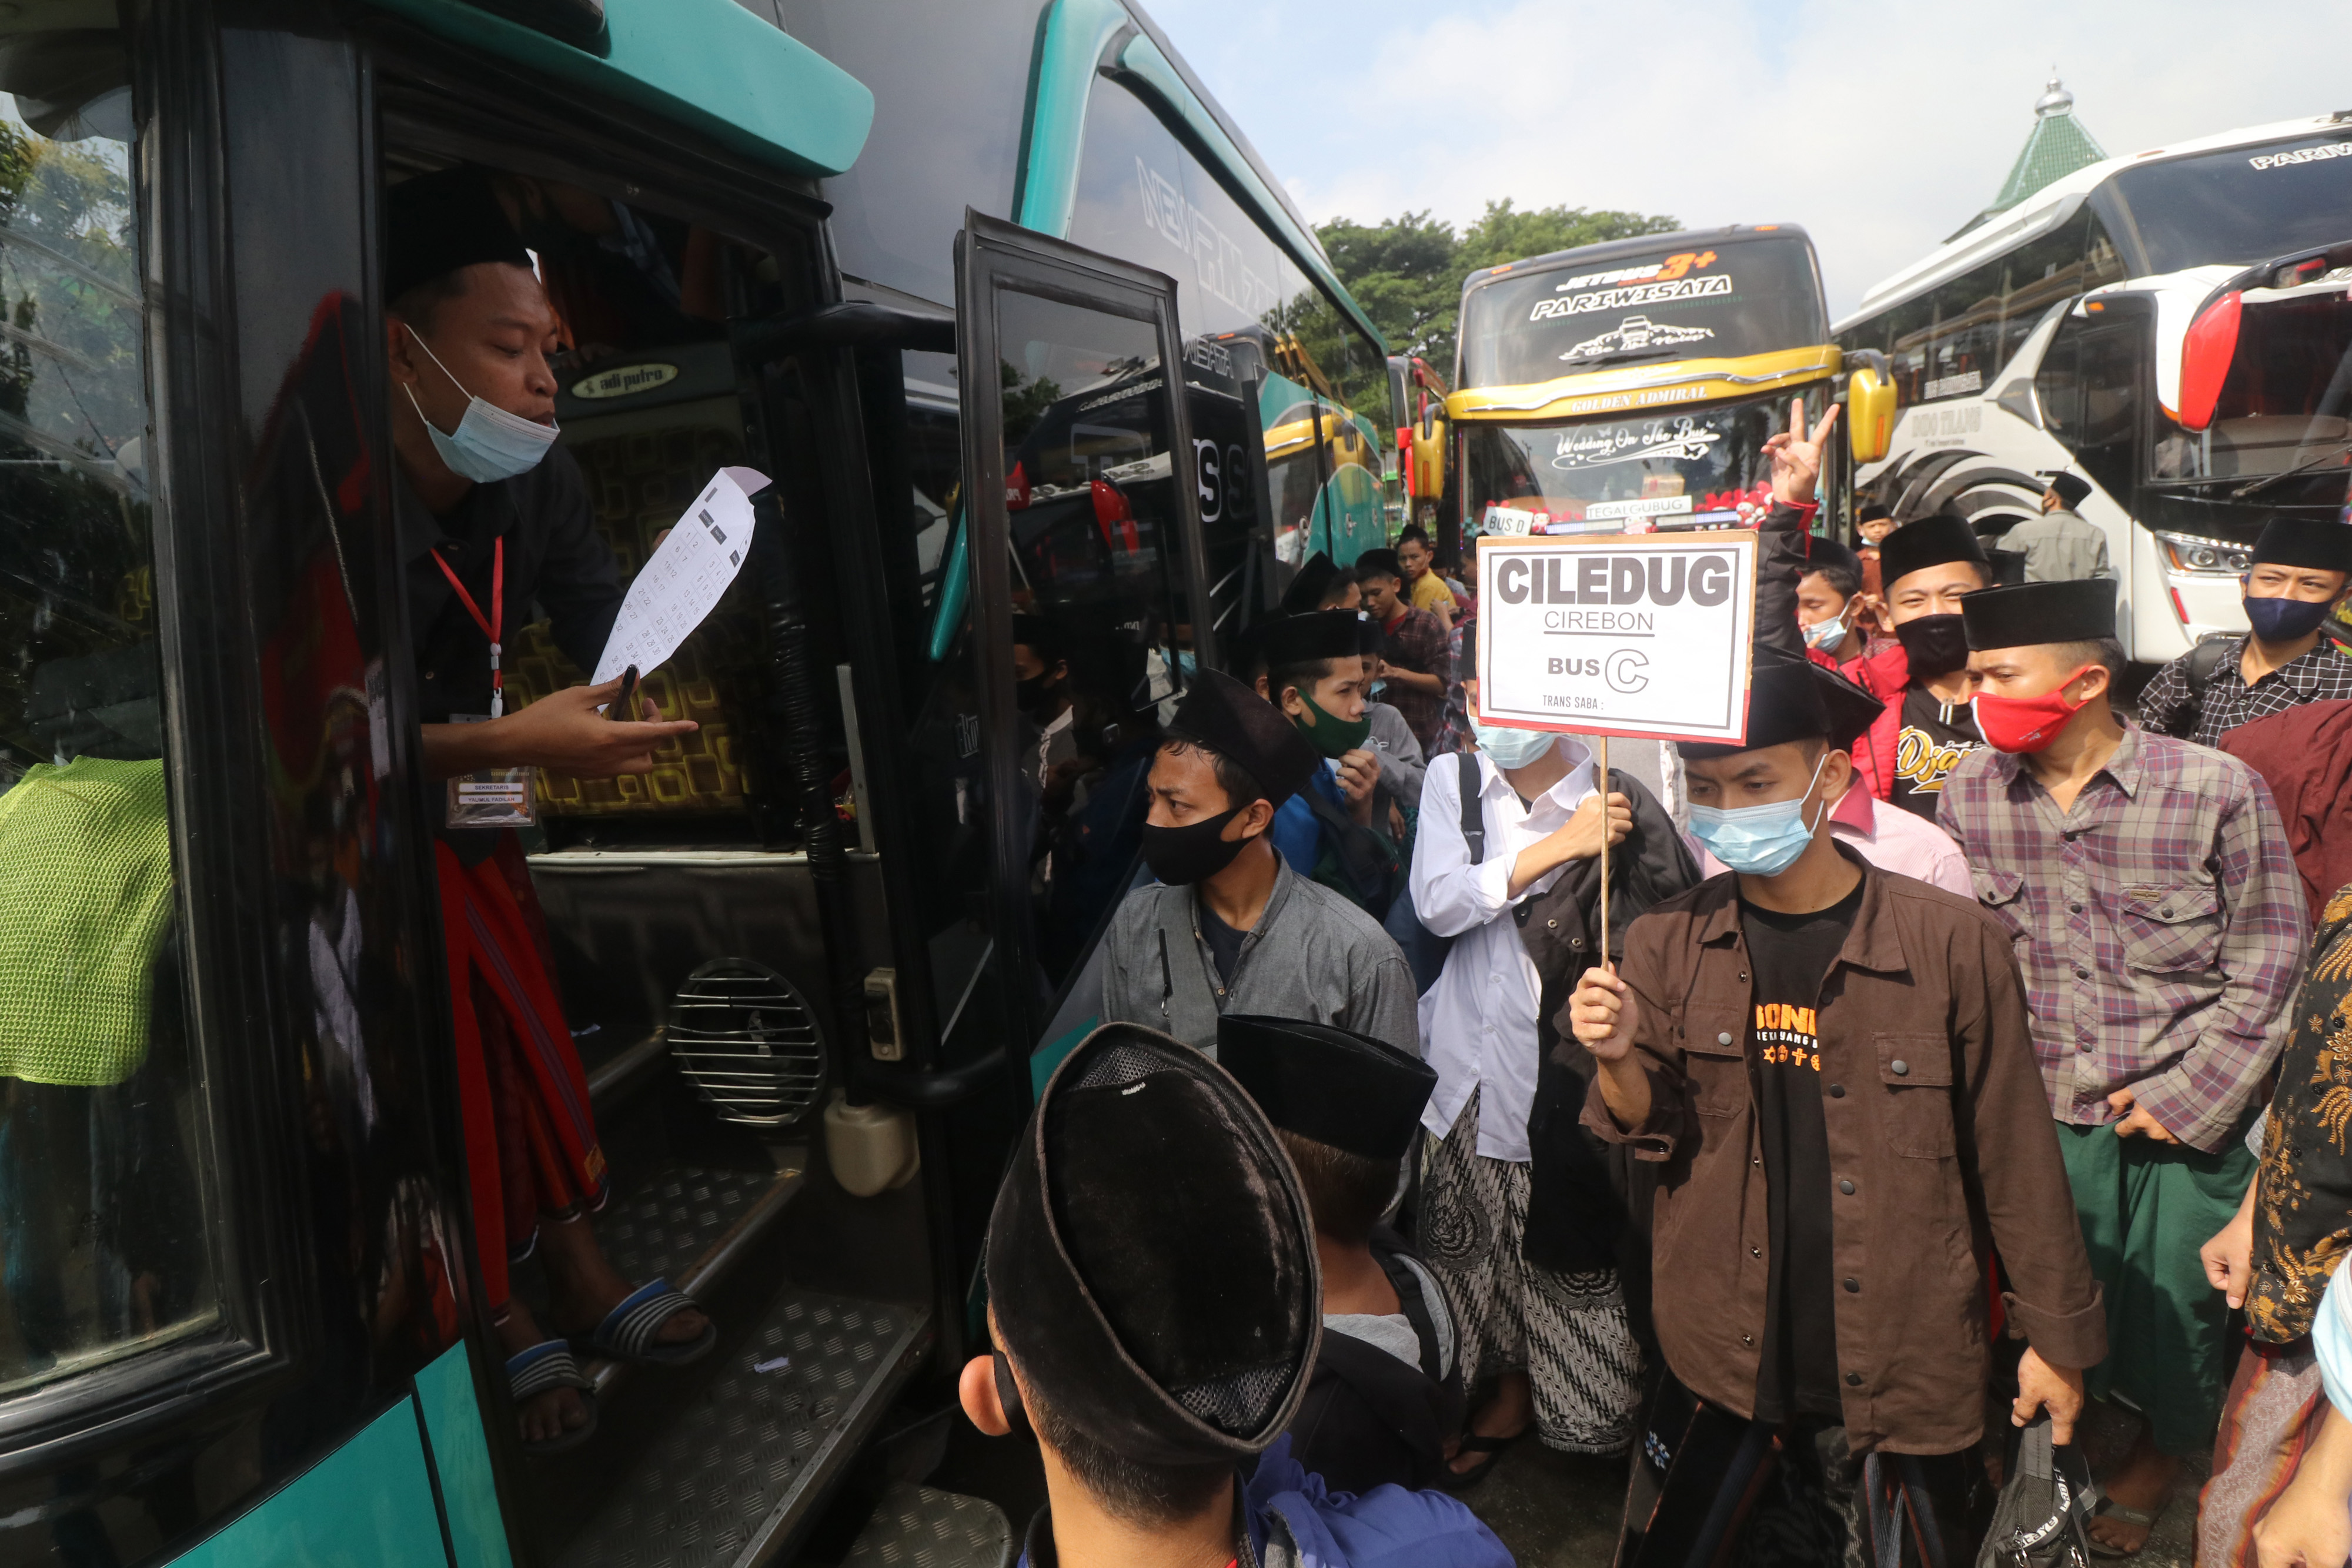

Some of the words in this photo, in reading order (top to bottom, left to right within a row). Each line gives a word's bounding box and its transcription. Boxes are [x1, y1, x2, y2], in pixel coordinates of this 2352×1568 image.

[1556, 264, 1664, 292] JETBUS
[1529, 275, 1732, 321] PARIWISATA
[600, 373, 620, 390] adi
[623, 369, 662, 390] putro
[1572, 395, 1631, 413] GOLDEN
[1636, 386, 1708, 405] ADMIRAL
[1553, 424, 1616, 456] Wedding
[1615, 427, 1639, 448] On
[1642, 420, 1672, 445] The
[1673, 416, 1707, 440] Bus
[1489, 516, 1512, 531] BUS
[1516, 520, 1524, 533] D
[1587, 499, 1682, 518] TEGALGUBUG
[653, 574, 659, 583] 16
[671, 603, 677, 612] 18
[664, 561, 671, 569] 11
[670, 569, 677, 579] 12
[684, 589, 690, 598] 13
[693, 607, 700, 616] 15
[1497, 555, 1730, 607] CILEDUG
[625, 601, 633, 611] 26
[630, 612, 638, 620] 27
[642, 630, 650, 638] 28
[647, 639, 656, 647] 29
[653, 647, 661, 656] 30
[638, 589, 646, 597] 21
[644, 597, 651, 606] 22
[656, 616, 664, 626] 23
[661, 626, 669, 635] 24
[667, 635, 674, 644] 25
[1544, 611, 1653, 631] CIREBON
[616, 623, 623, 632] 32
[631, 651, 639, 660] 34
[1548, 657, 1600, 676] BUS
[1605, 648, 1649, 694] C
[1542, 694, 1571, 708] TRANS
[1574, 696, 1598, 710] SABA
